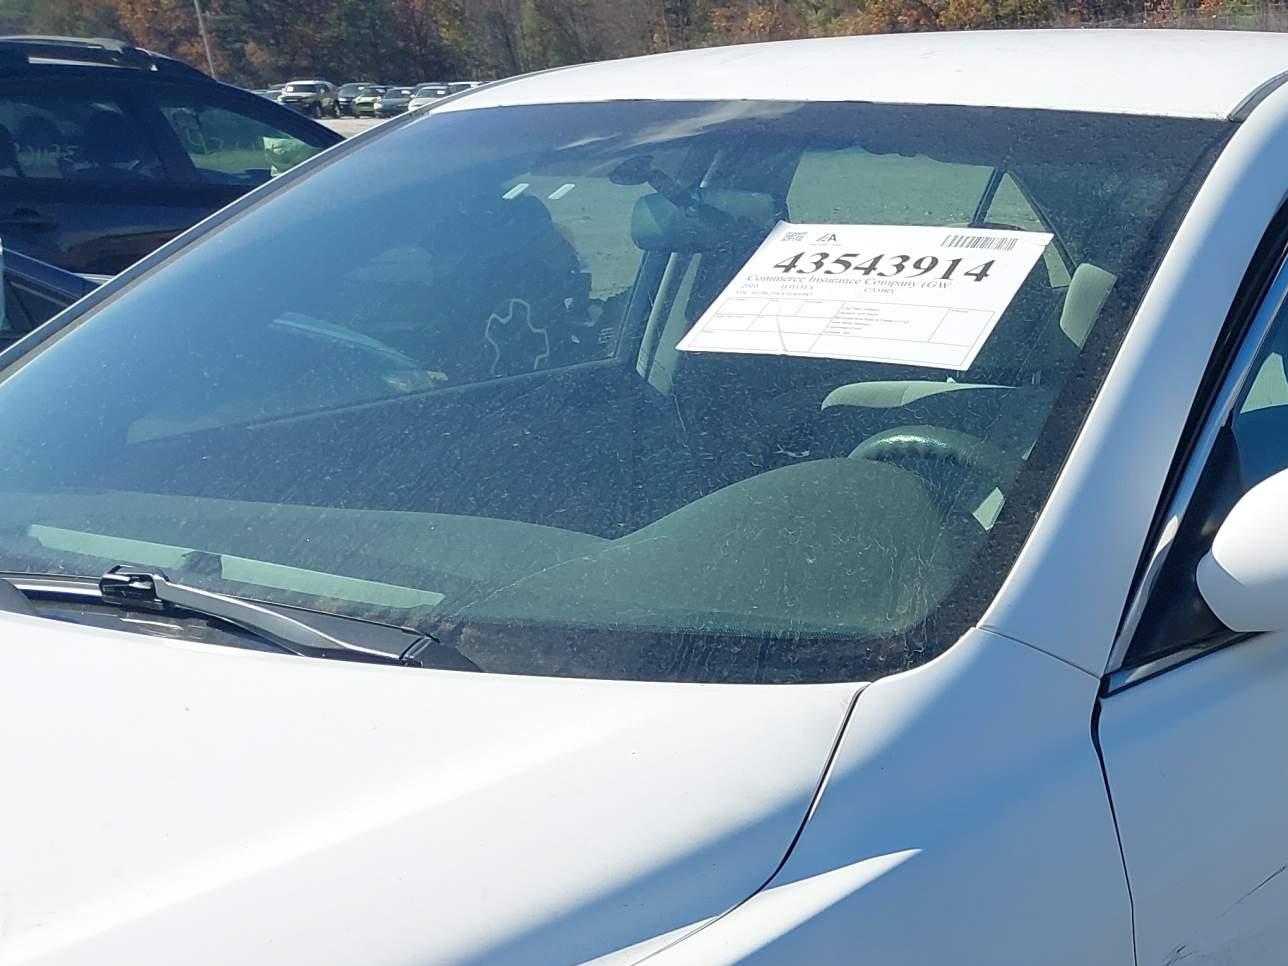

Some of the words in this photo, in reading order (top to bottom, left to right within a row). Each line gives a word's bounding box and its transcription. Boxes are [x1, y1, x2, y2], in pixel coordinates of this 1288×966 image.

[773, 251, 996, 282] 43543914
[747, 274, 806, 283] Commerce
[808, 275, 862, 285] Insurance
[864, 278, 916, 288] Company
